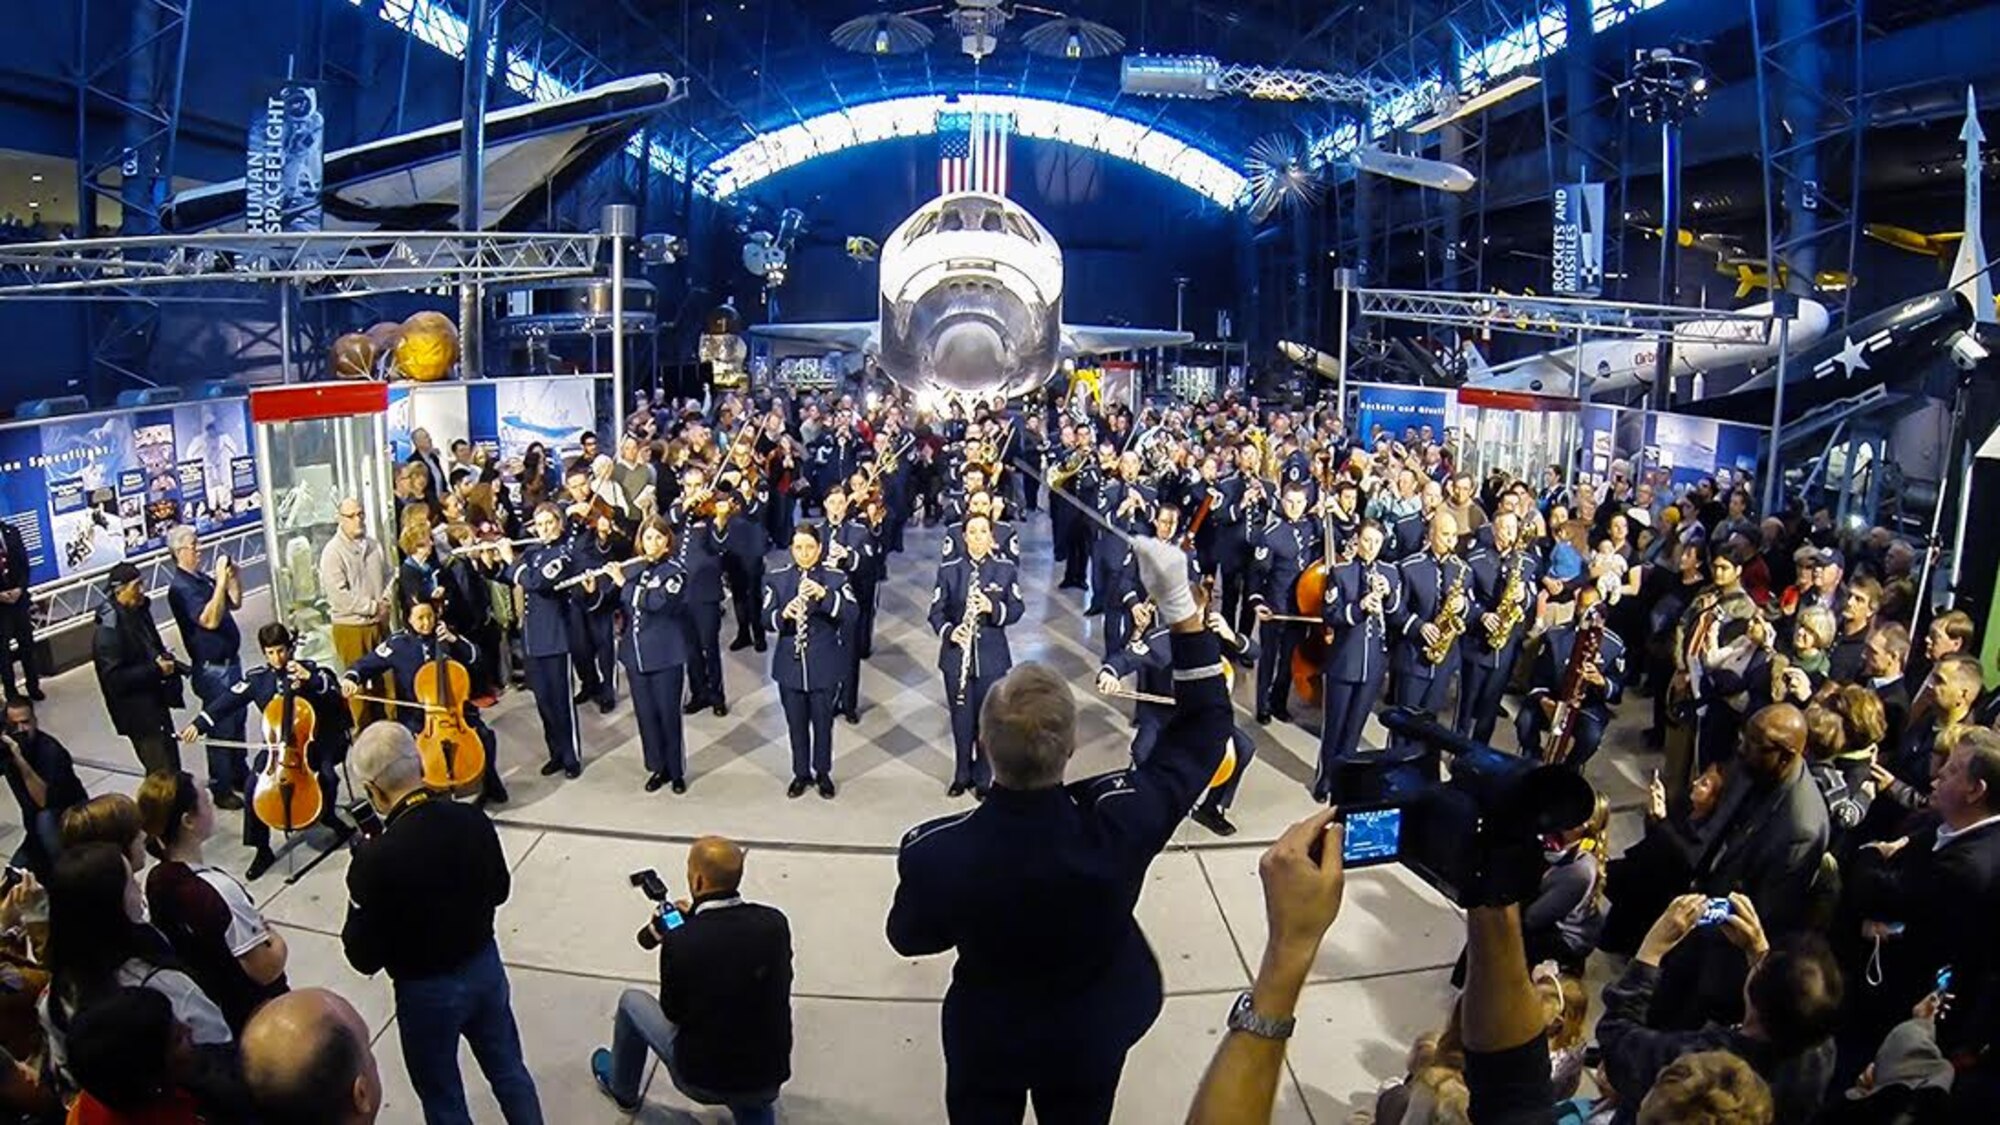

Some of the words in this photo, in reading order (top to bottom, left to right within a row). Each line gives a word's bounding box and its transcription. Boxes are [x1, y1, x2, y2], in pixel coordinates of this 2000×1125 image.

[247, 151, 264, 233] HUMAN
[265, 96, 285, 233] SPACEFLIGHT
[1554, 189, 1567, 221] AND
[1552, 224, 1566, 292] ROCKETS
[1564, 224, 1578, 292] MISSILES
